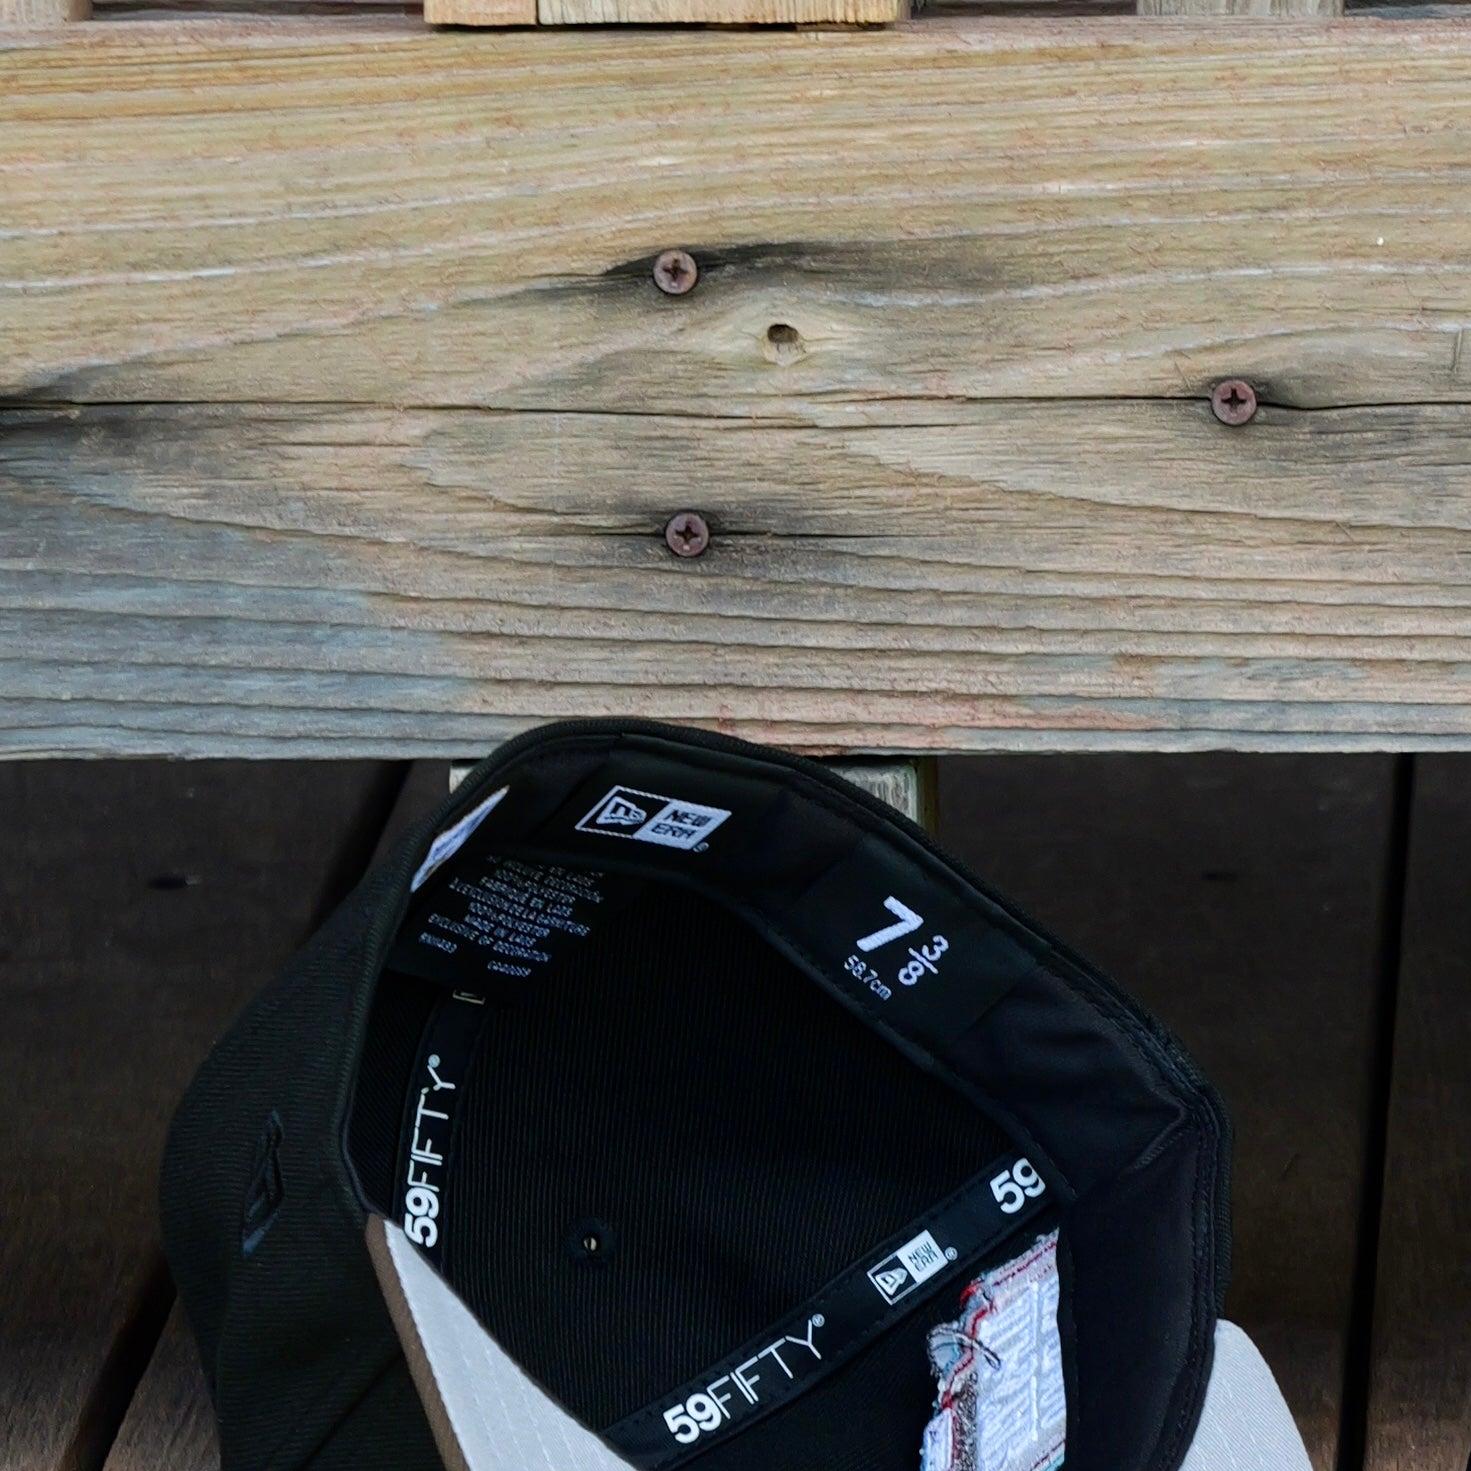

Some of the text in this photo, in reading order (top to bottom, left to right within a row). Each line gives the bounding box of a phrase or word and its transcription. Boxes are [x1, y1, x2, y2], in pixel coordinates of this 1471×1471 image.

[662, 808, 713, 829] NEW
[651, 823, 697, 840] ERA
[856, 896, 925, 953] 7
[844, 954, 893, 1001] 58.7cm
[989, 1157, 1047, 1214] 59
[907, 1240, 936, 1264] NEW
[912, 1249, 941, 1273] ERA
